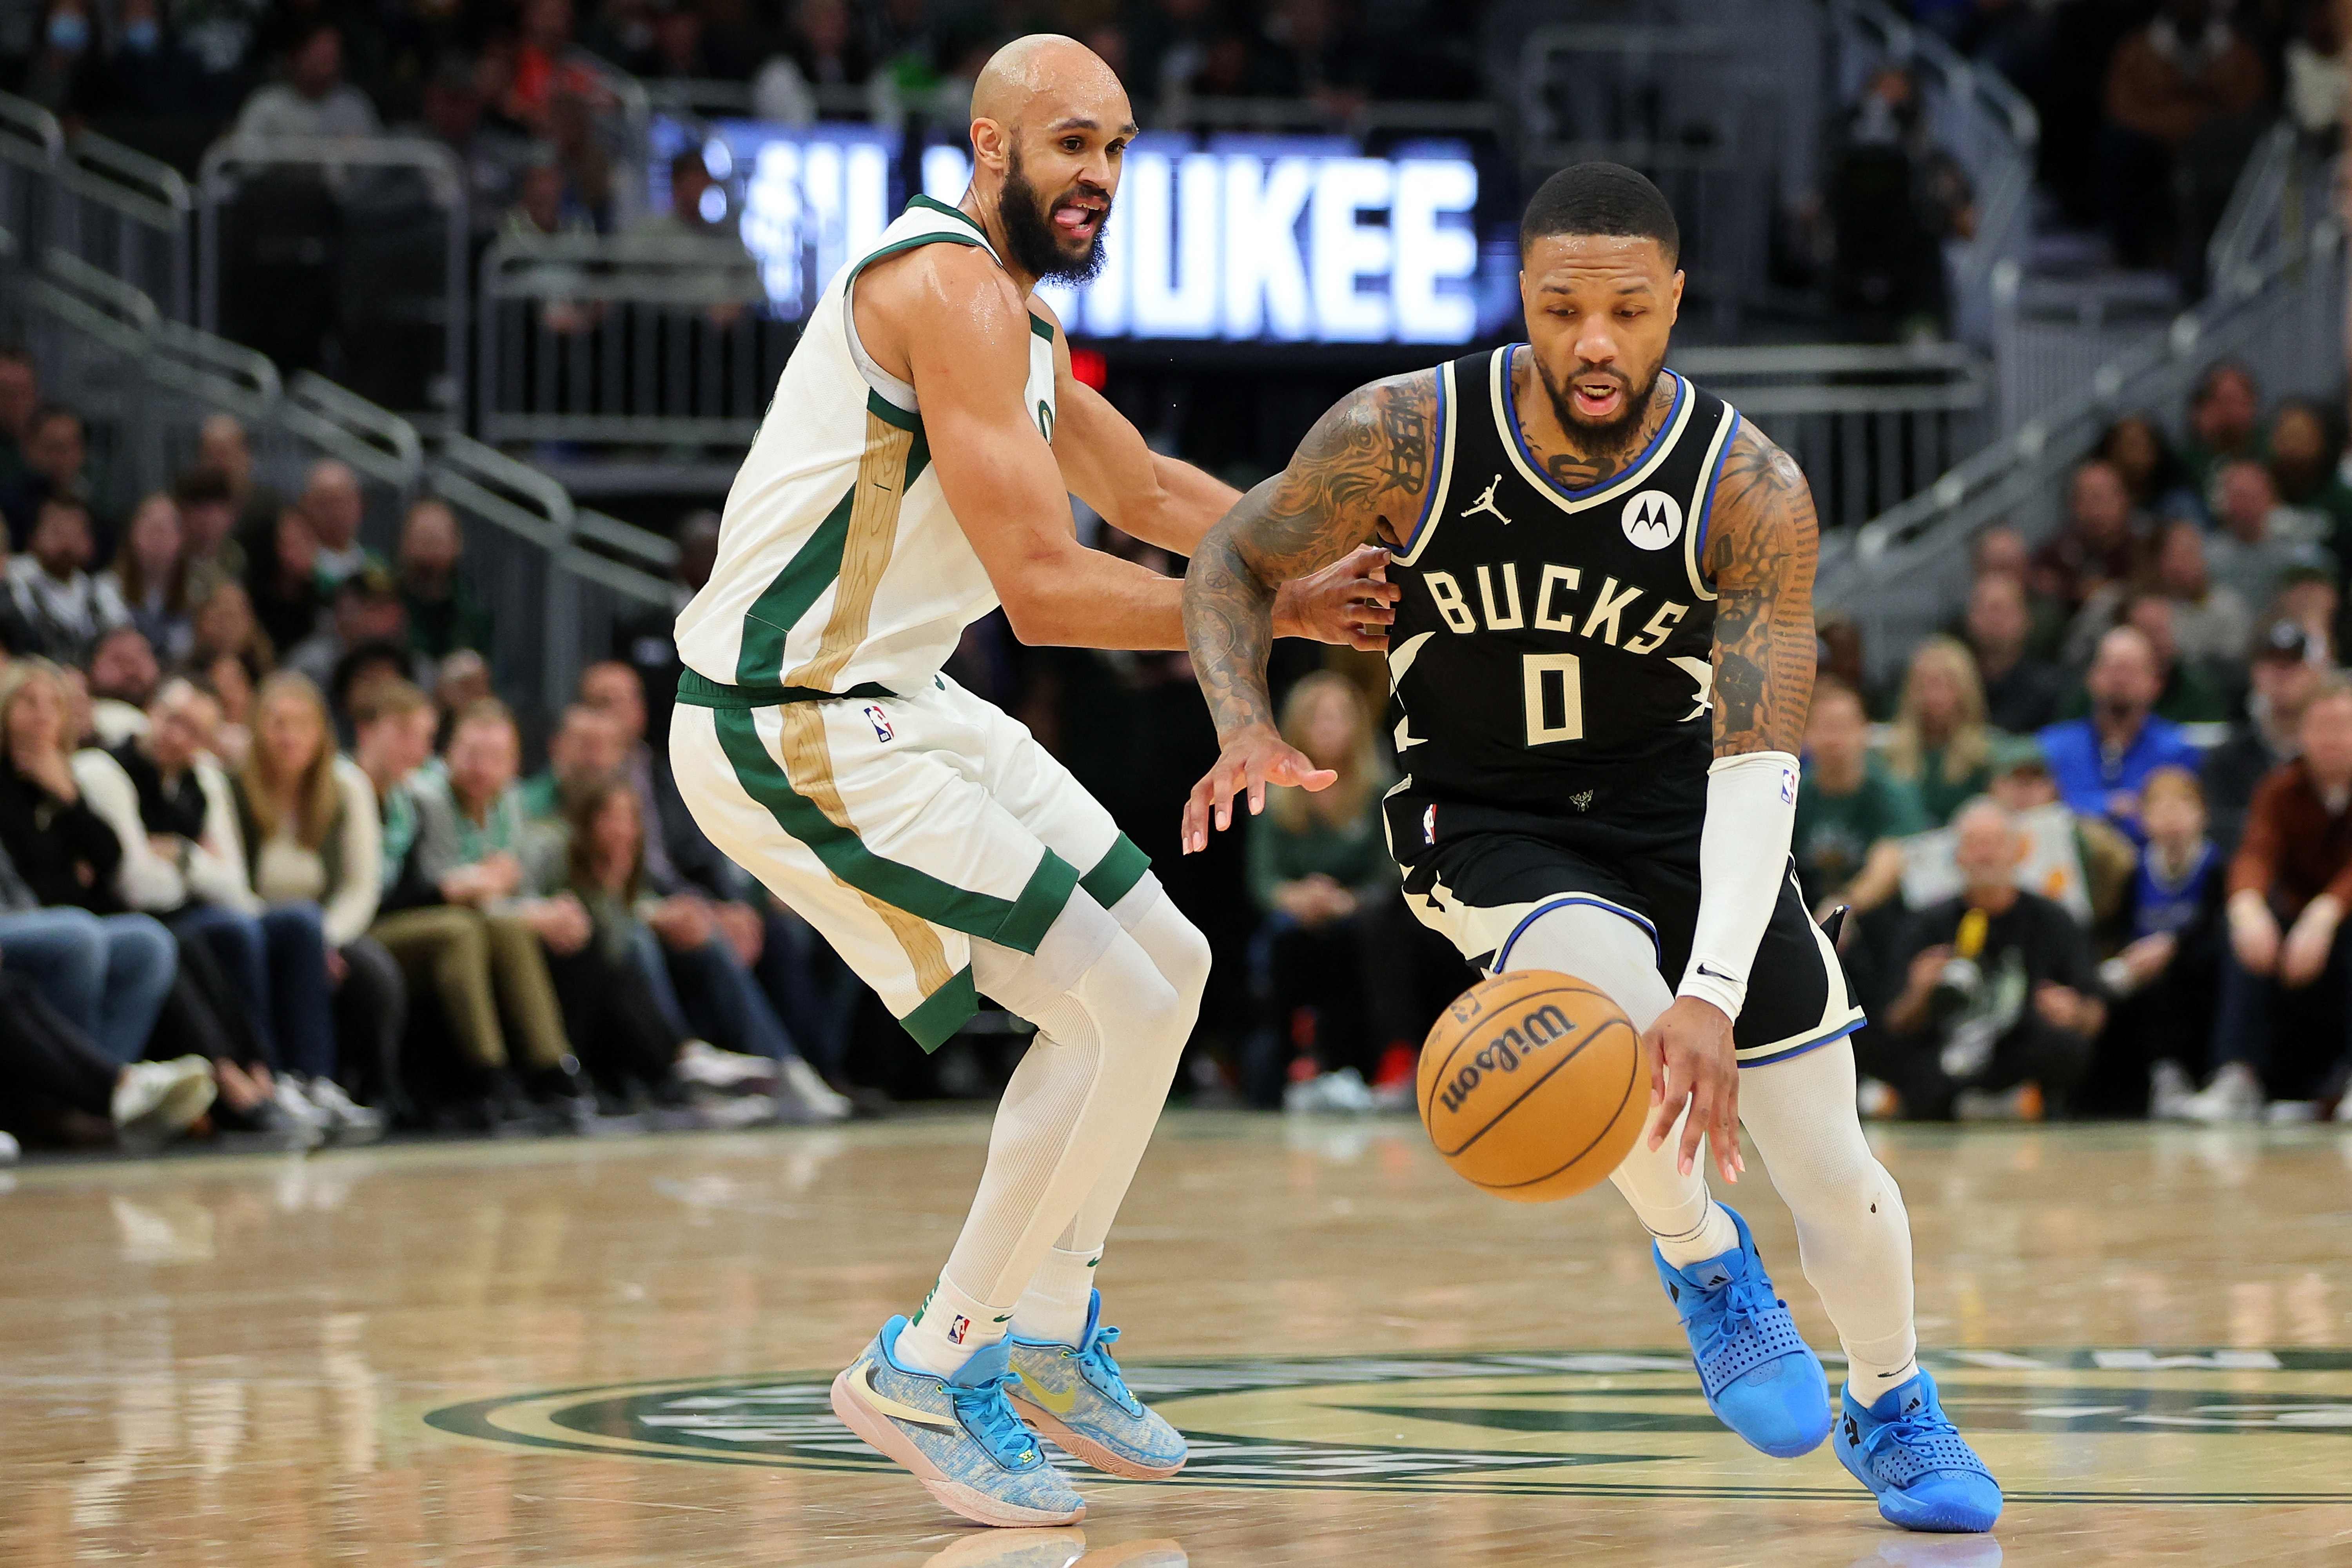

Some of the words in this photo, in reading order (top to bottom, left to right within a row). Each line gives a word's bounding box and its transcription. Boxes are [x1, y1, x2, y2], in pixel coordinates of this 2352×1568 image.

[1423, 562, 1689, 654] BUCKS
[1523, 652, 1584, 748] 0
[1440, 1004, 1578, 1114] Wilson
